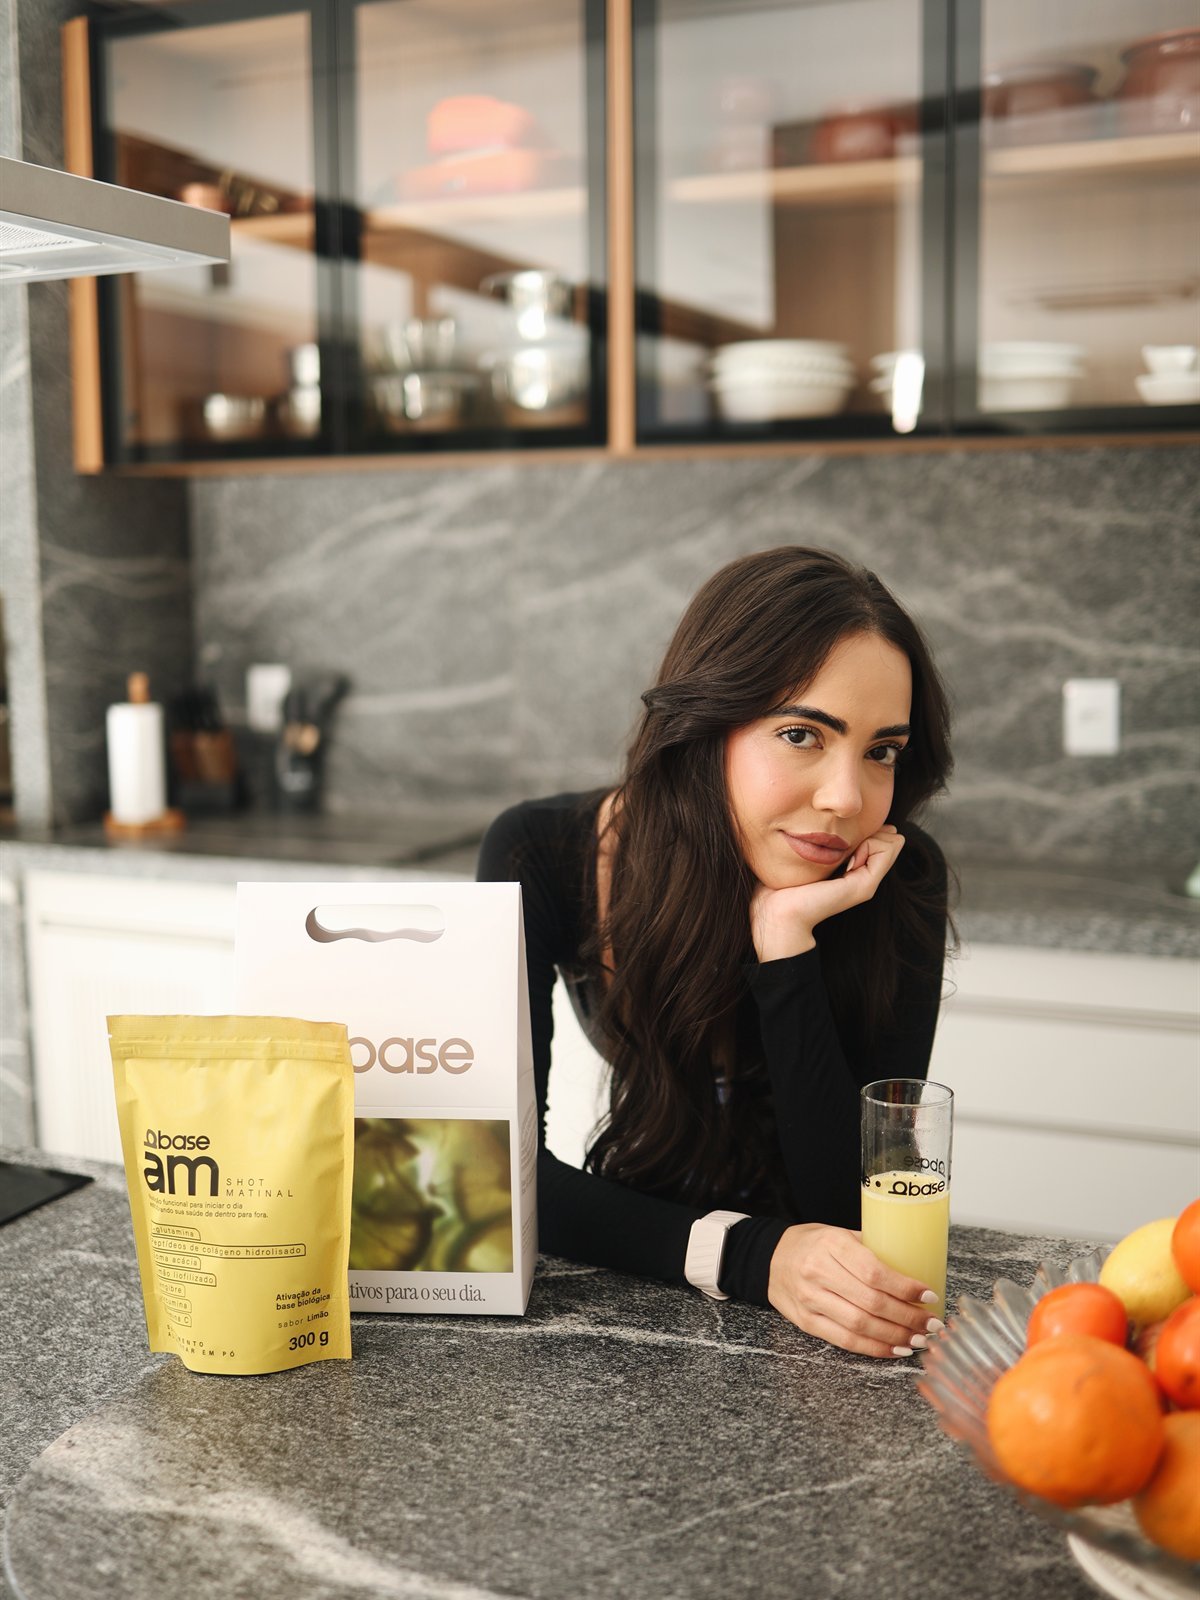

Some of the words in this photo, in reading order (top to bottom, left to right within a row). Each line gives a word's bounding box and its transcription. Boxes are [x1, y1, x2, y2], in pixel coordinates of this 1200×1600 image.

[143, 1151, 219, 1197] am
[226, 1177, 265, 1187] SHOT
[225, 1188, 294, 1198] MATINAL
[162, 1199, 188, 1208] funcional
[205, 1201, 225, 1209] iniciar
[232, 1202, 243, 1210] dia
[186, 1209, 204, 1217] saúde
[214, 1210, 236, 1218] dentro
[237, 1211, 253, 1219] para
[254, 1211, 269, 1219] fora.
[152, 1226, 194, 1237] -glutamina
[190, 1244, 199, 1252] de
[203, 1247, 241, 1256] colágeno
[245, 1247, 301, 1256] hidrolisado
[172, 1256, 198, 1266] acácia
[173, 1269, 214, 1284] liofilizado
[276, 1291, 310, 1301] Ativação
[349, 1282, 383, 1299] tivos
[385, 1286, 418, 1304] para
[421, 1287, 430, 1301] o
[432, 1287, 456, 1301] seu
[459, 1284, 486, 1302] dia.
[297, 1294, 331, 1308] biológica
[278, 1318, 304, 1329] sabor
[307, 1311, 329, 1322] Limão
[289, 1331, 316, 1351] 300
[319, 1331, 329, 1346] g
